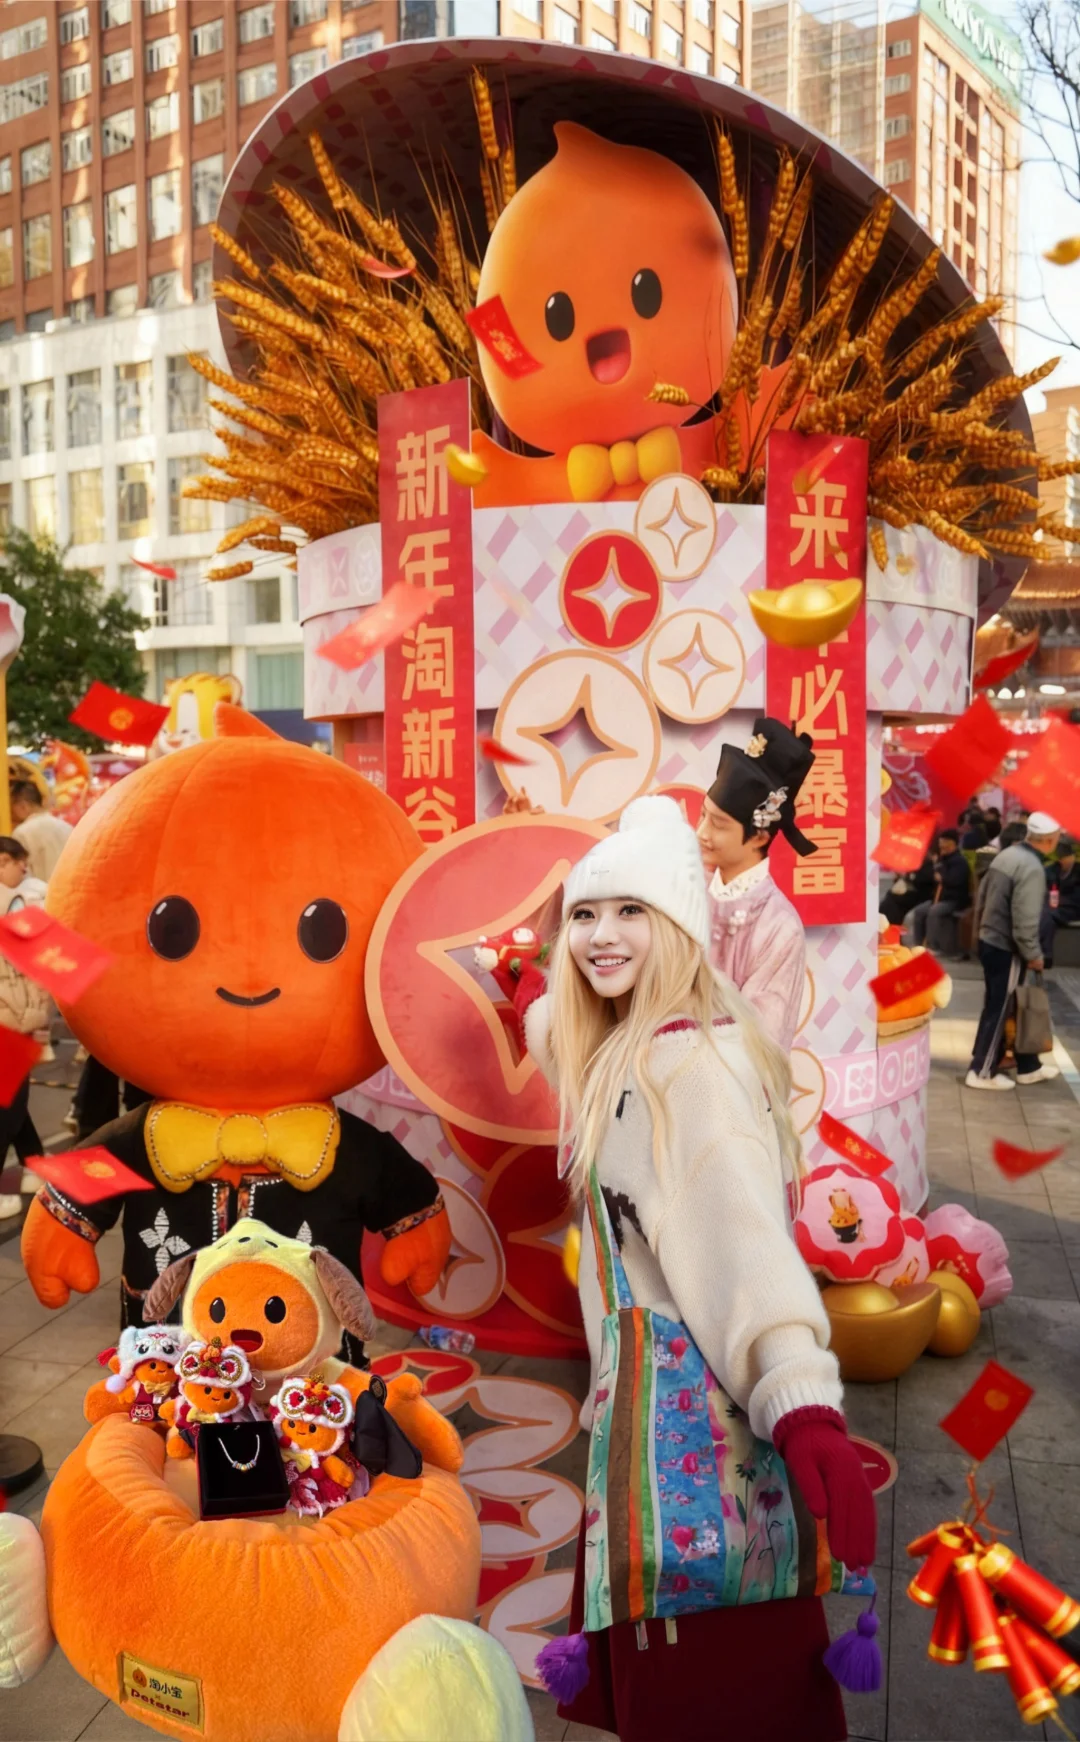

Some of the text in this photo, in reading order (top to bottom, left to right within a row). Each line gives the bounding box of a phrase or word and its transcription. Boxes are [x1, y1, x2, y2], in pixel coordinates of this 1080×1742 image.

[395, 424, 457, 848] 新年淘新谷
[789, 478, 849, 895] 来必暴富
[149, 1677, 182, 1699] 淘小宝
